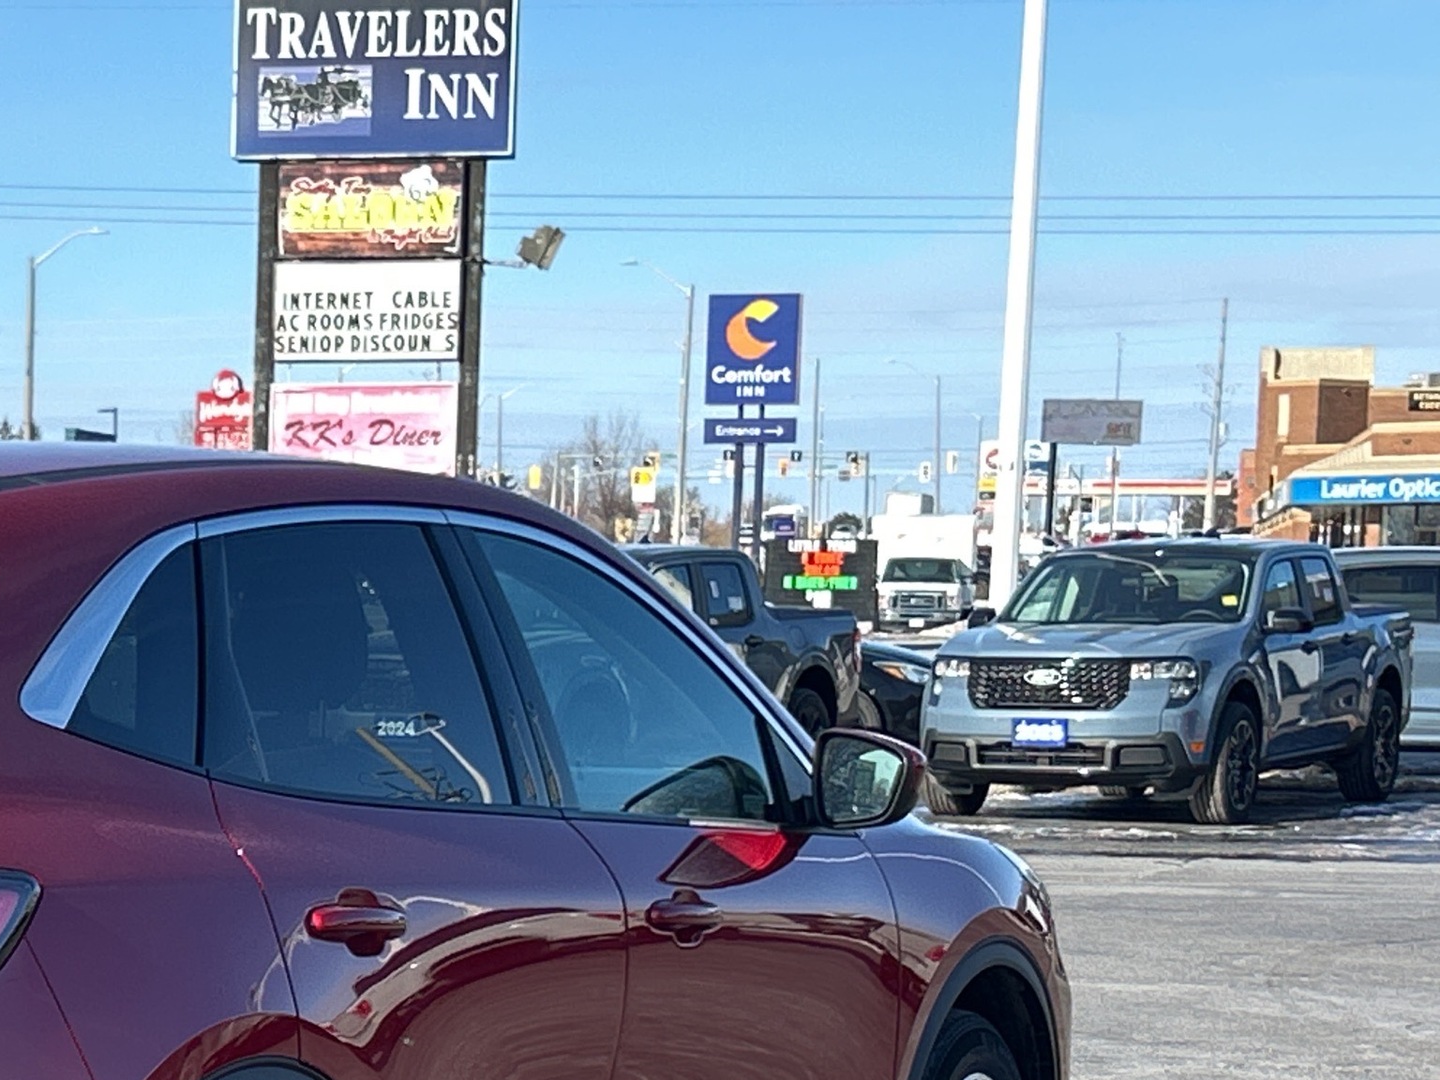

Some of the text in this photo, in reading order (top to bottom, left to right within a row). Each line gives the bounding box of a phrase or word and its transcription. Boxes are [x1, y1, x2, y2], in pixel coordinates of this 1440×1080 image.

[247, 8, 507, 60] TRAVELERS
[403, 68, 498, 120] INN
[282, 291, 452, 311] INTERNET CABLE
[276, 312, 459, 332] AC ROOMS FRIDGES
[711, 364, 792, 384] Comfort
[736, 385, 766, 397] INN
[284, 418, 356, 449] KK's
[367, 418, 443, 447] Diner
[1320, 479, 1388, 500] Laurier
